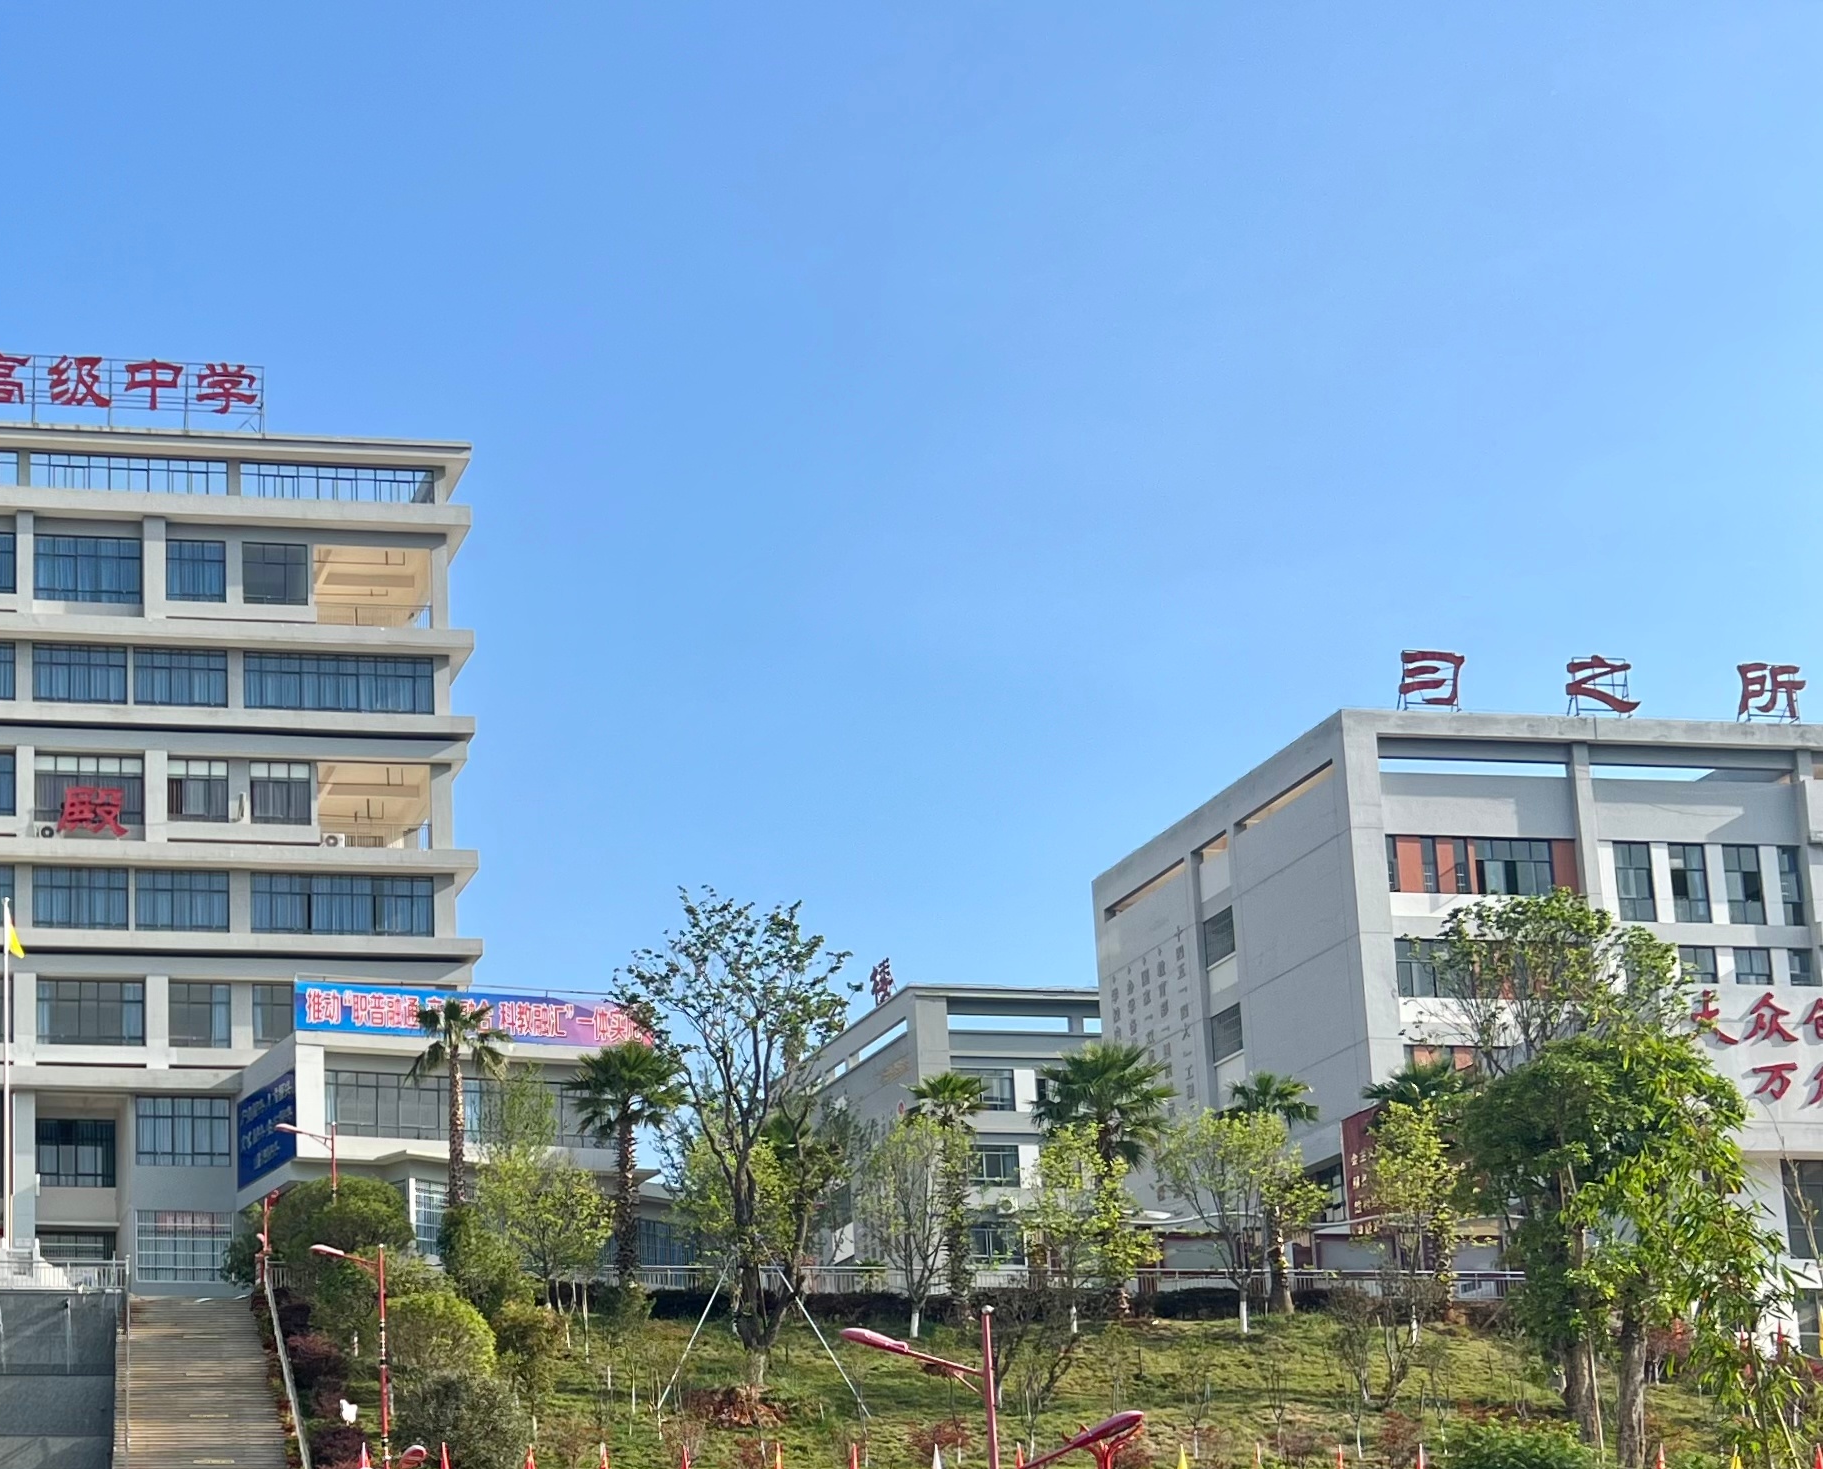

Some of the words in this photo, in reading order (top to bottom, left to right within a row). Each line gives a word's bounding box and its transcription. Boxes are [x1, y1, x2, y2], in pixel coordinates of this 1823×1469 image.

[305, 988, 420, 1029] 推动“职普融通
